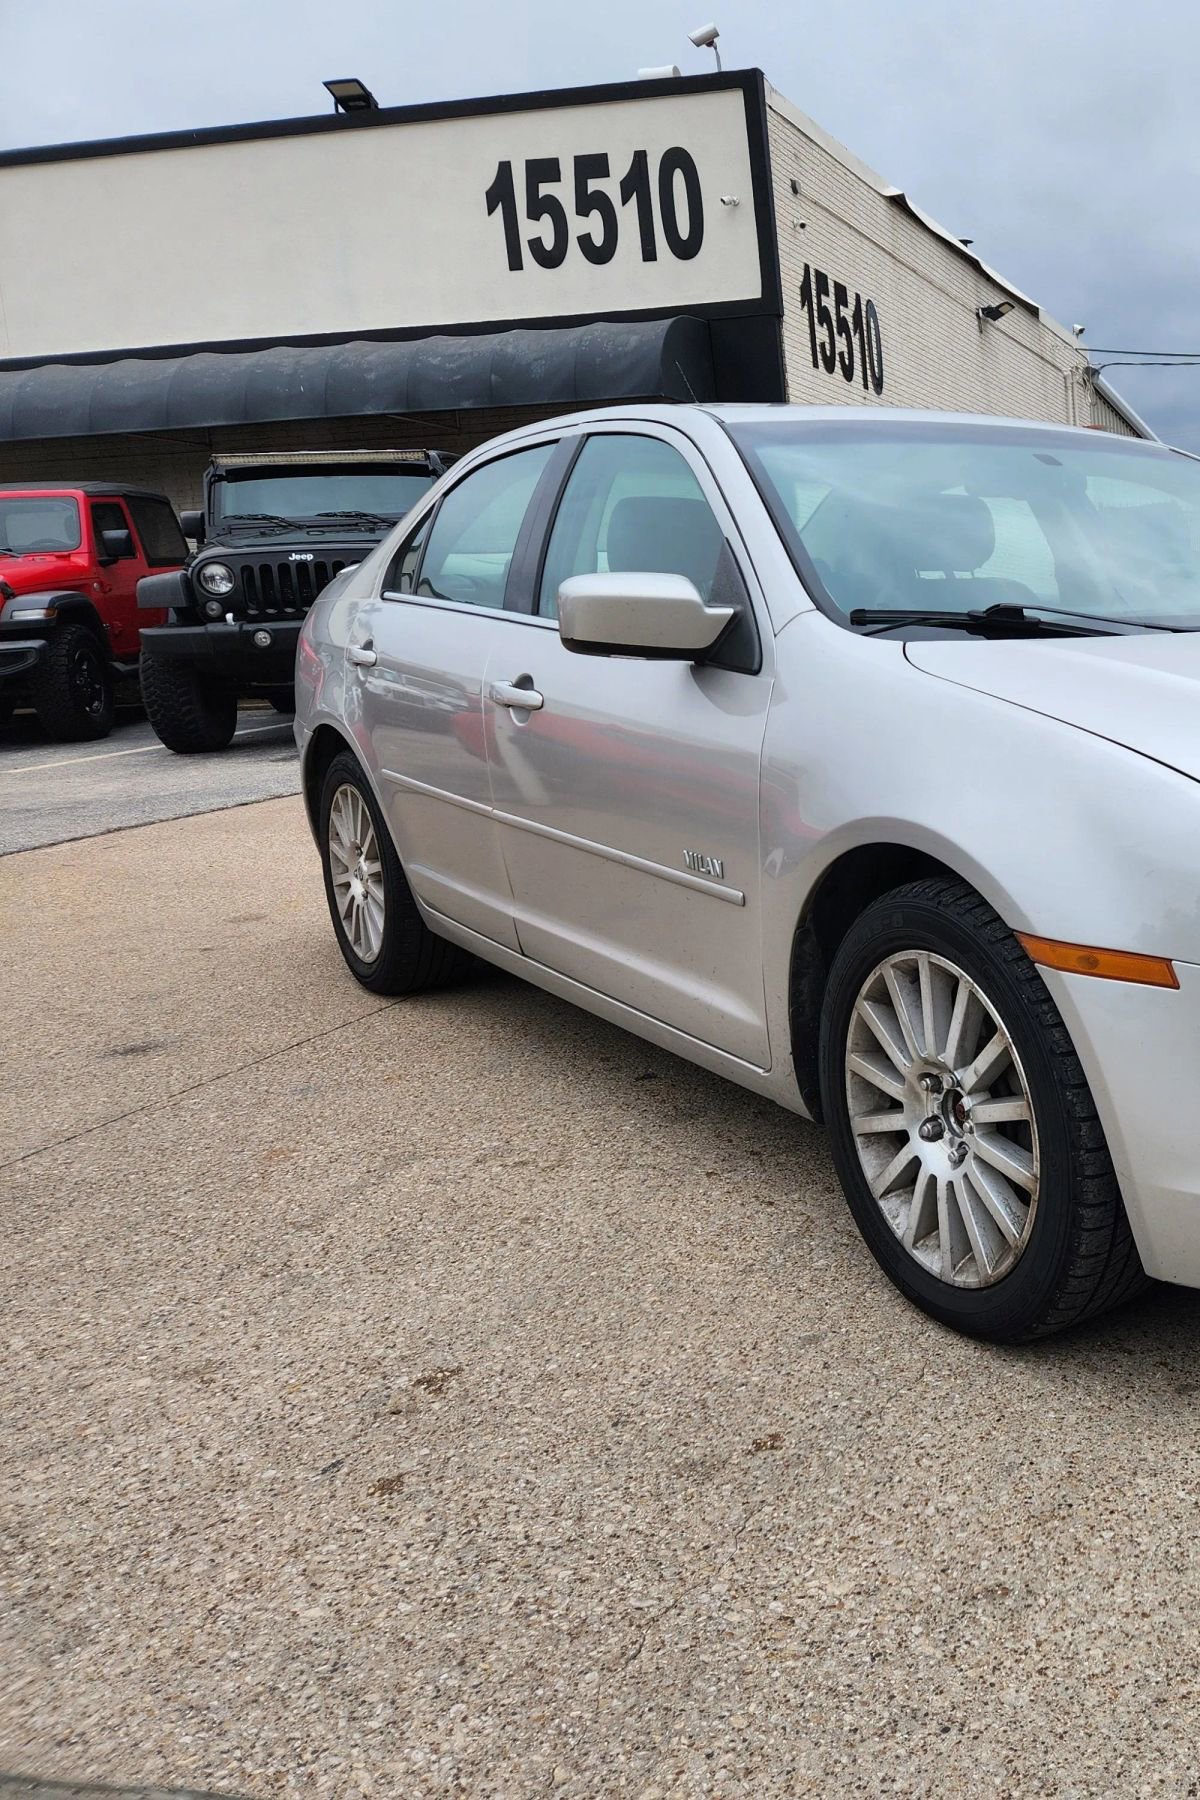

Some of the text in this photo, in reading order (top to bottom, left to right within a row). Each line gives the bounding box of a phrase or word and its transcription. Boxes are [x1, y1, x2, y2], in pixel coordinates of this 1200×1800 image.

[485, 146, 704, 271] 15510
[799, 262, 883, 395] 15510
[288, 552, 314, 561] Jeep
[683, 849, 724, 879] MILAN
